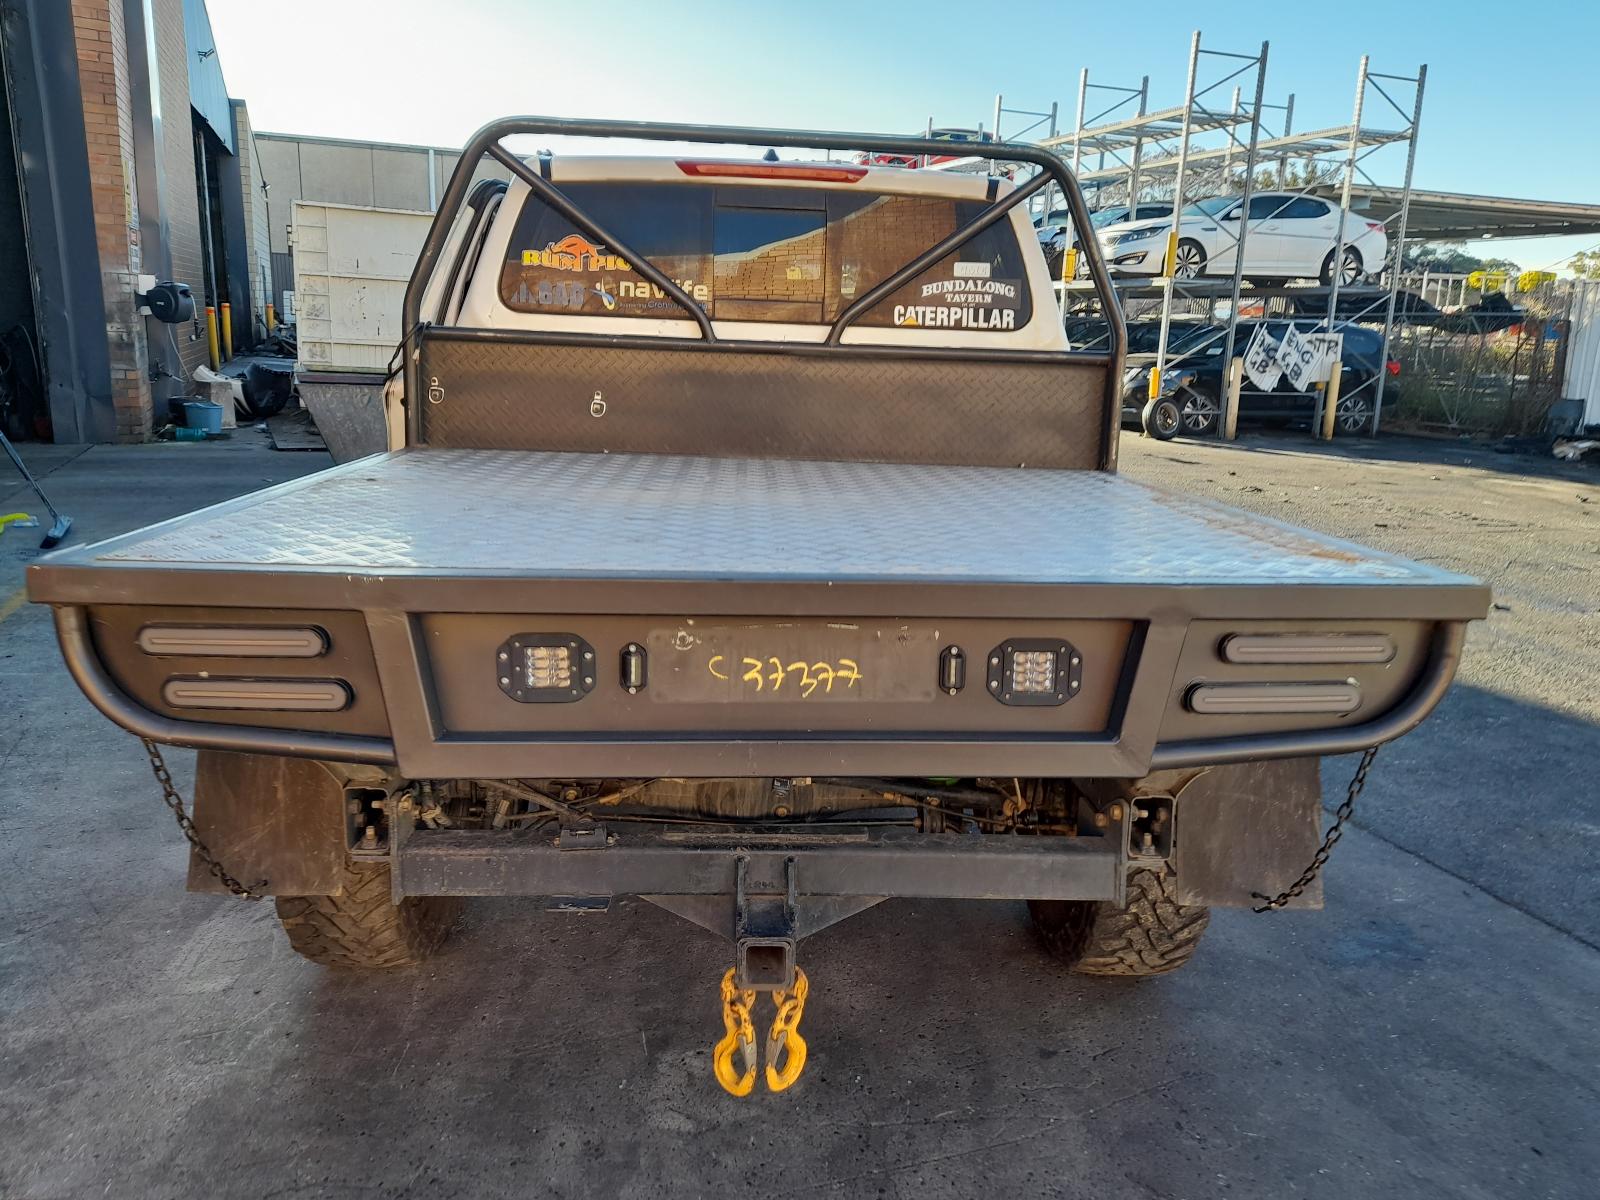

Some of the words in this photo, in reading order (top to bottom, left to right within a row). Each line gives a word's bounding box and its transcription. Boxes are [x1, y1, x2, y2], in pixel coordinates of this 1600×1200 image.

[921, 279, 1016, 298] BUNDALONG
[945, 293, 993, 304] TAVERN
[893, 304, 1015, 330] CATERPILLAR
